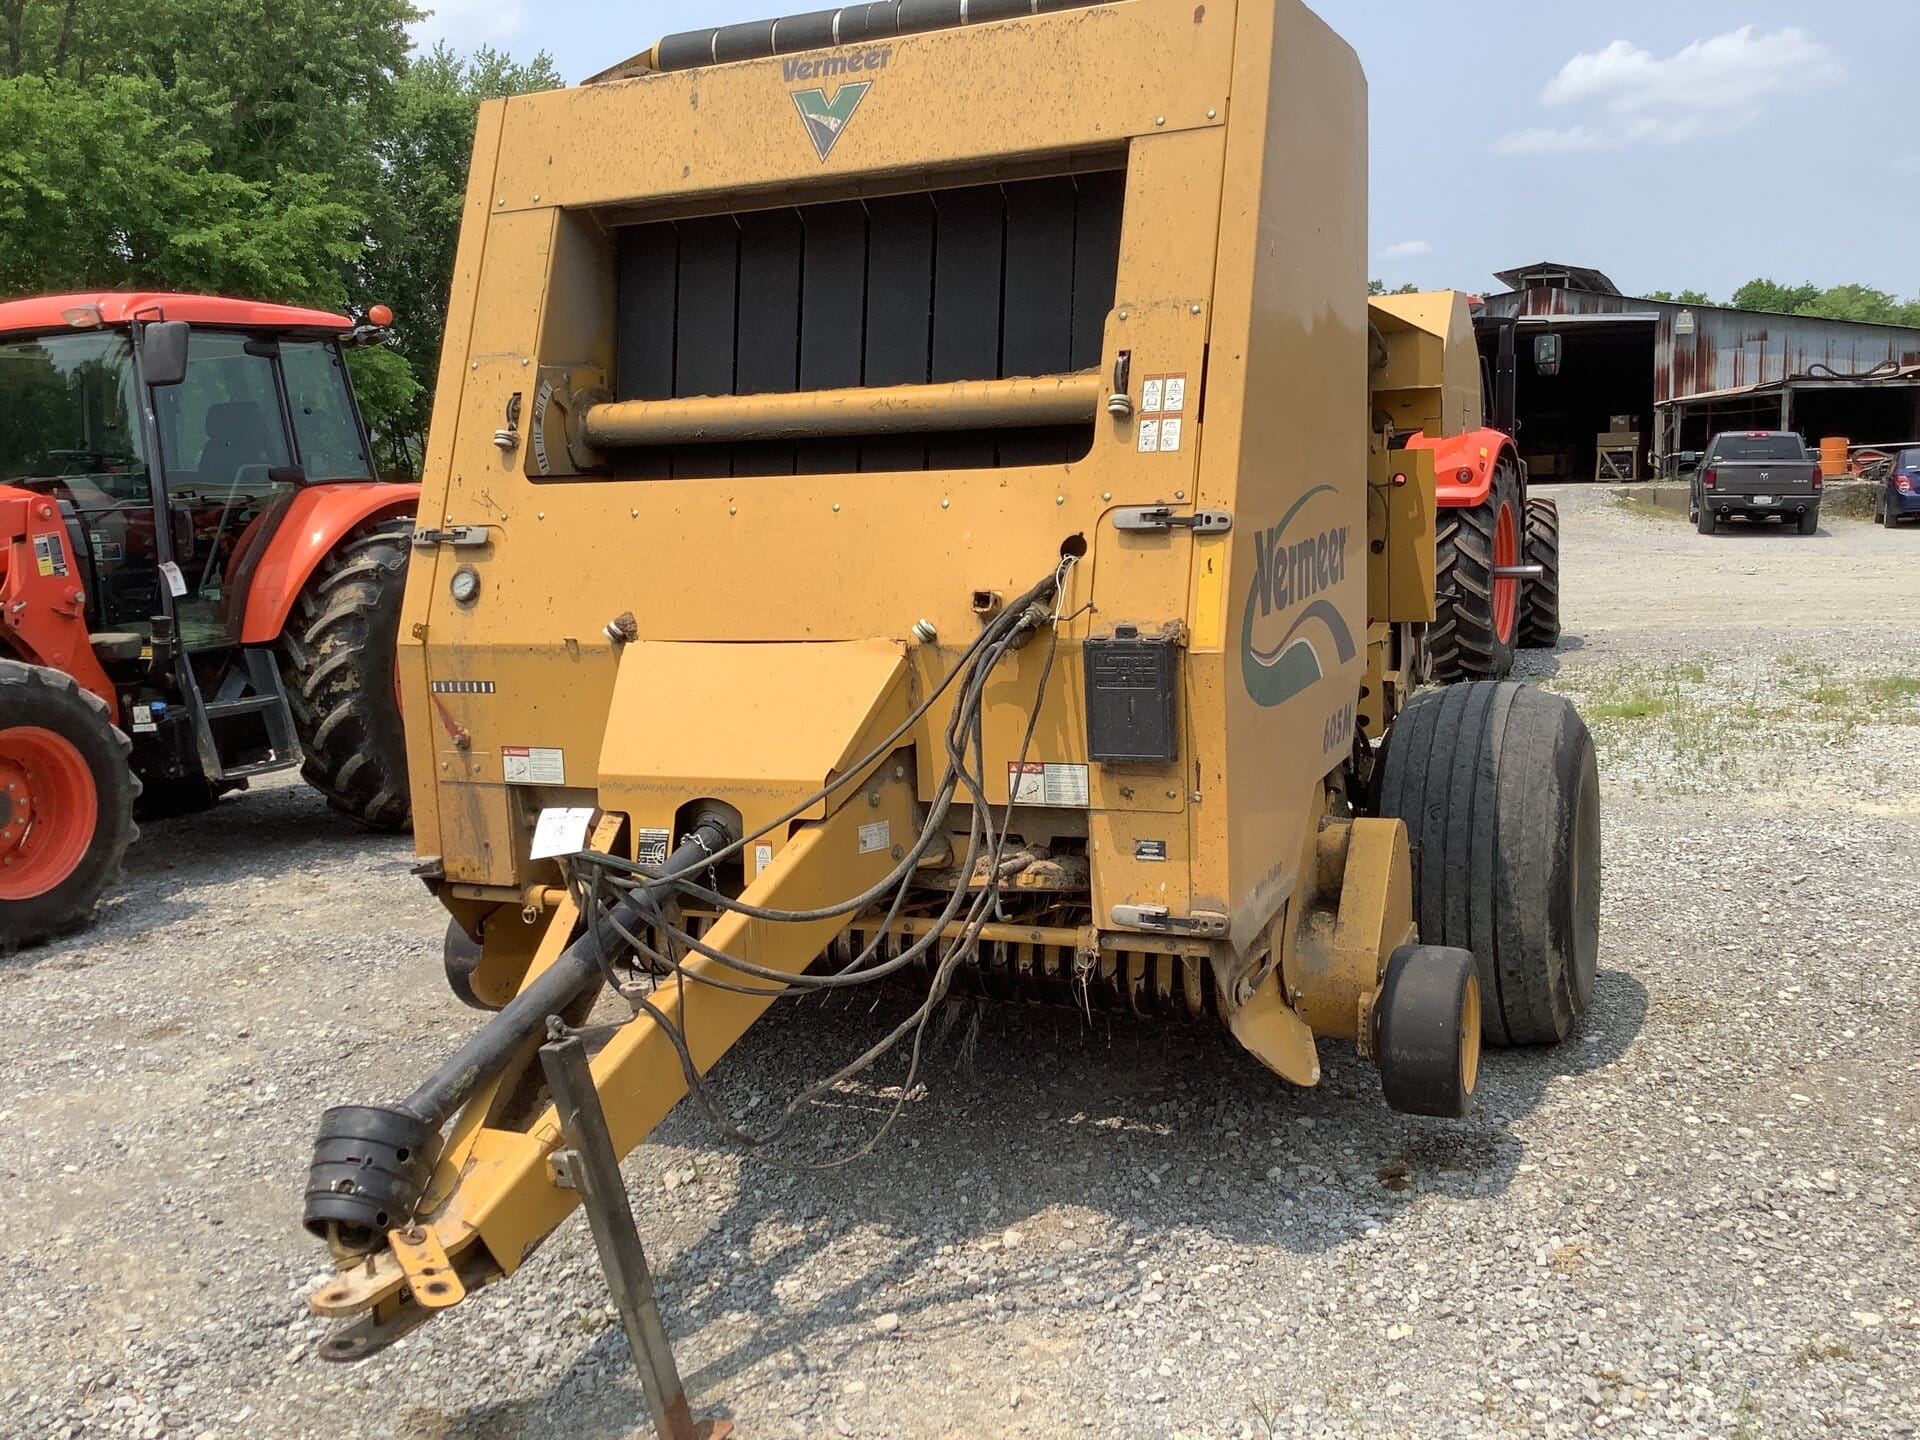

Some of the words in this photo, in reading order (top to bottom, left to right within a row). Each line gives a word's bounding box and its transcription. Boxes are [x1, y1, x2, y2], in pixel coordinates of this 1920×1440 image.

[783, 49, 892, 82] Vermeer
[1255, 527, 1347, 617] Vermeer
[1322, 702, 1352, 755] 605M
